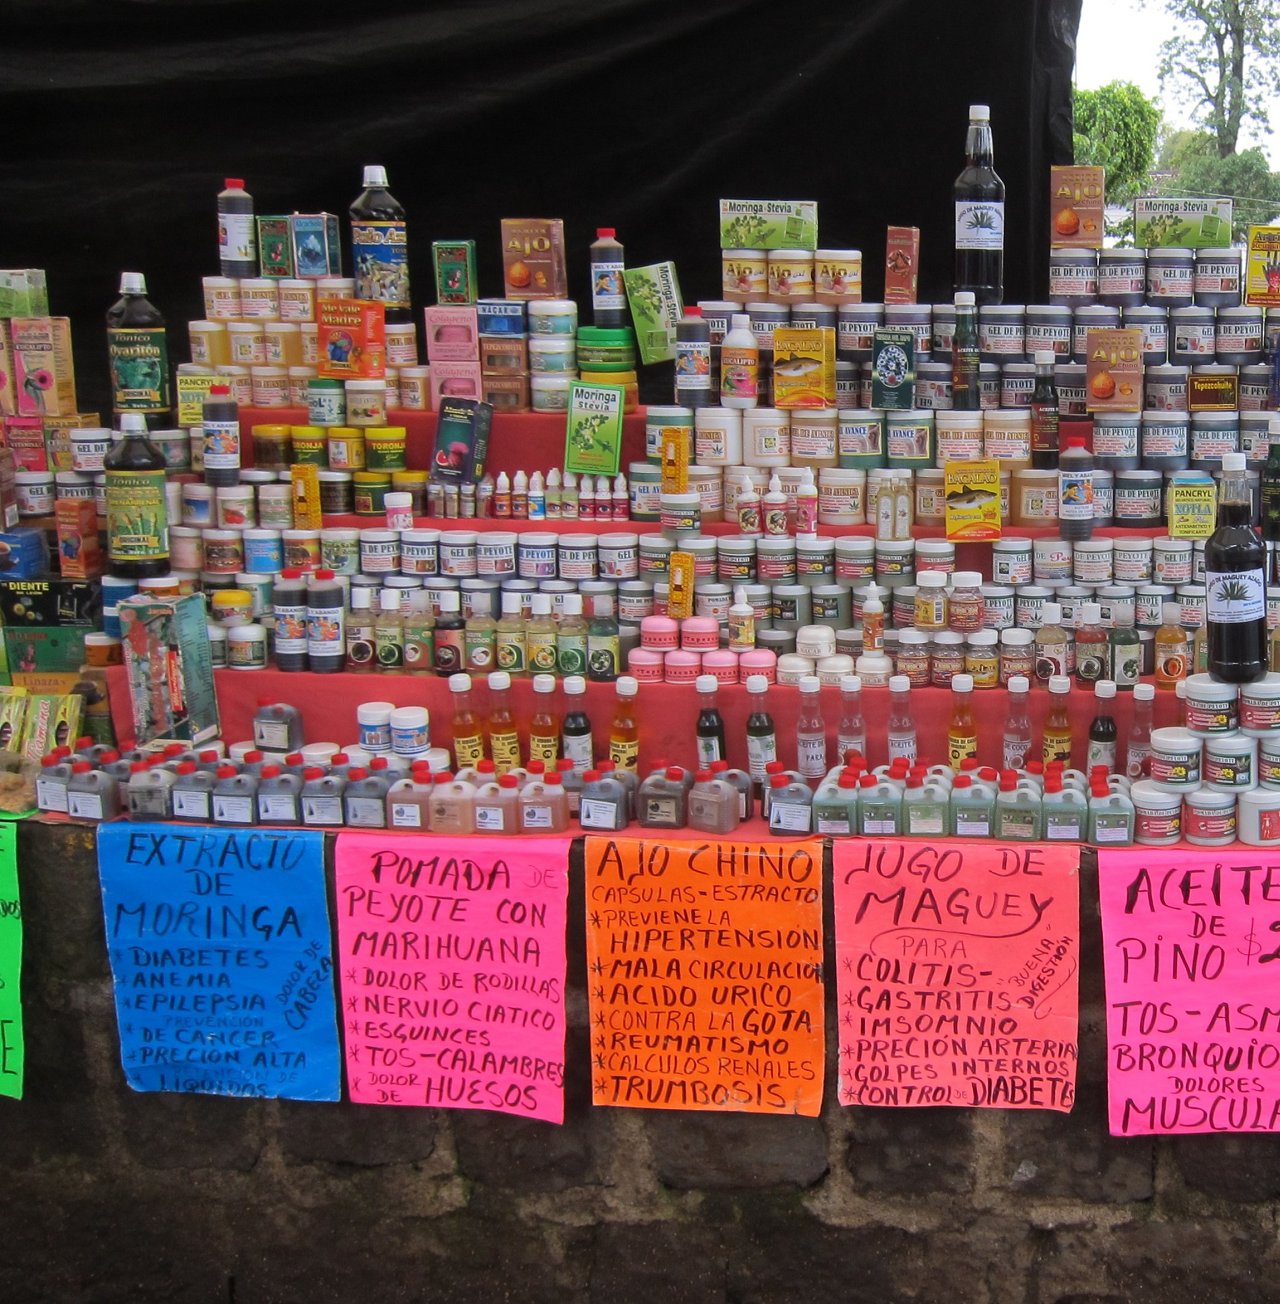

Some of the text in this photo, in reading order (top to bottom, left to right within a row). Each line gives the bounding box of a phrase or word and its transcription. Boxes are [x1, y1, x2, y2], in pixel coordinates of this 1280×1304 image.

[729, 202, 792, 214] Moringa Stevia
[1145, 201, 1208, 213] Moringa Stevia
[1163, 269, 1177, 278] GEL
[1210, 264, 1237, 274] PEYOTE
[659, 266, 673, 301] Moringa
[1043, 328, 1069, 337] PEYOTE
[574, 389, 616, 402] Moringa
[578, 402, 610, 411] Stevia
[947, 473, 997, 485] BACALAO
[9, 582, 49, 591] DIENTE
[126, 832, 306, 867] EXTRACTO
[371, 850, 558, 890] POMADA DE
[597, 841, 814, 884] AJO CHINO
[844, 846, 1044, 884] JUGO DE
[190, 870, 234, 897] DE
[343, 885, 545, 927] PEYOTE CON
[855, 888, 1054, 931] MAGUEY
[112, 901, 303, 939] MORINGA
[605, 909, 731, 927] PREVIENE LA
[1188, 912, 1226, 938] DE
[133, 948, 269, 968] DIABETES
[351, 932, 541, 967] MARIHUANA
[899, 936, 967, 958] PARA
[611, 959, 681, 979] MALA
[1116, 935, 1226, 983] PINO
[133, 972, 231, 988] ANEMIA
[363, 968, 560, 1003] DOLOR DE RODILLAS
[134, 995, 266, 1012] EPILEPSIA
[283, 957, 334, 1031] CABEZA
[610, 984, 792, 1007] ACIDO URICO
[857, 989, 1011, 1013] GASTRITIS
[364, 995, 555, 1031] NERVIO CIATICO
[609, 1010, 812, 1034] CONTRA LA GOTA
[860, 1015, 1018, 1036] IMSOMNIO
[143, 1028, 278, 1047] DE CANCER
[611, 1034, 789, 1055] REUMATISMO
[140, 1047, 306, 1068] PRECION ALTA
[609, 1054, 815, 1080] CALCULOS RENALES
[368, 1072, 421, 1088] DOLOR
[855, 1058, 1070, 1085] GOLPES INTERNOS
[377, 1089, 401, 1102] DE
[425, 1075, 537, 1111] HUESOS
[610, 1077, 787, 1108] TRUMBOSIS
[856, 1085, 952, 1104] CONTROL
[1168, 1076, 1264, 1094] DOLORES
